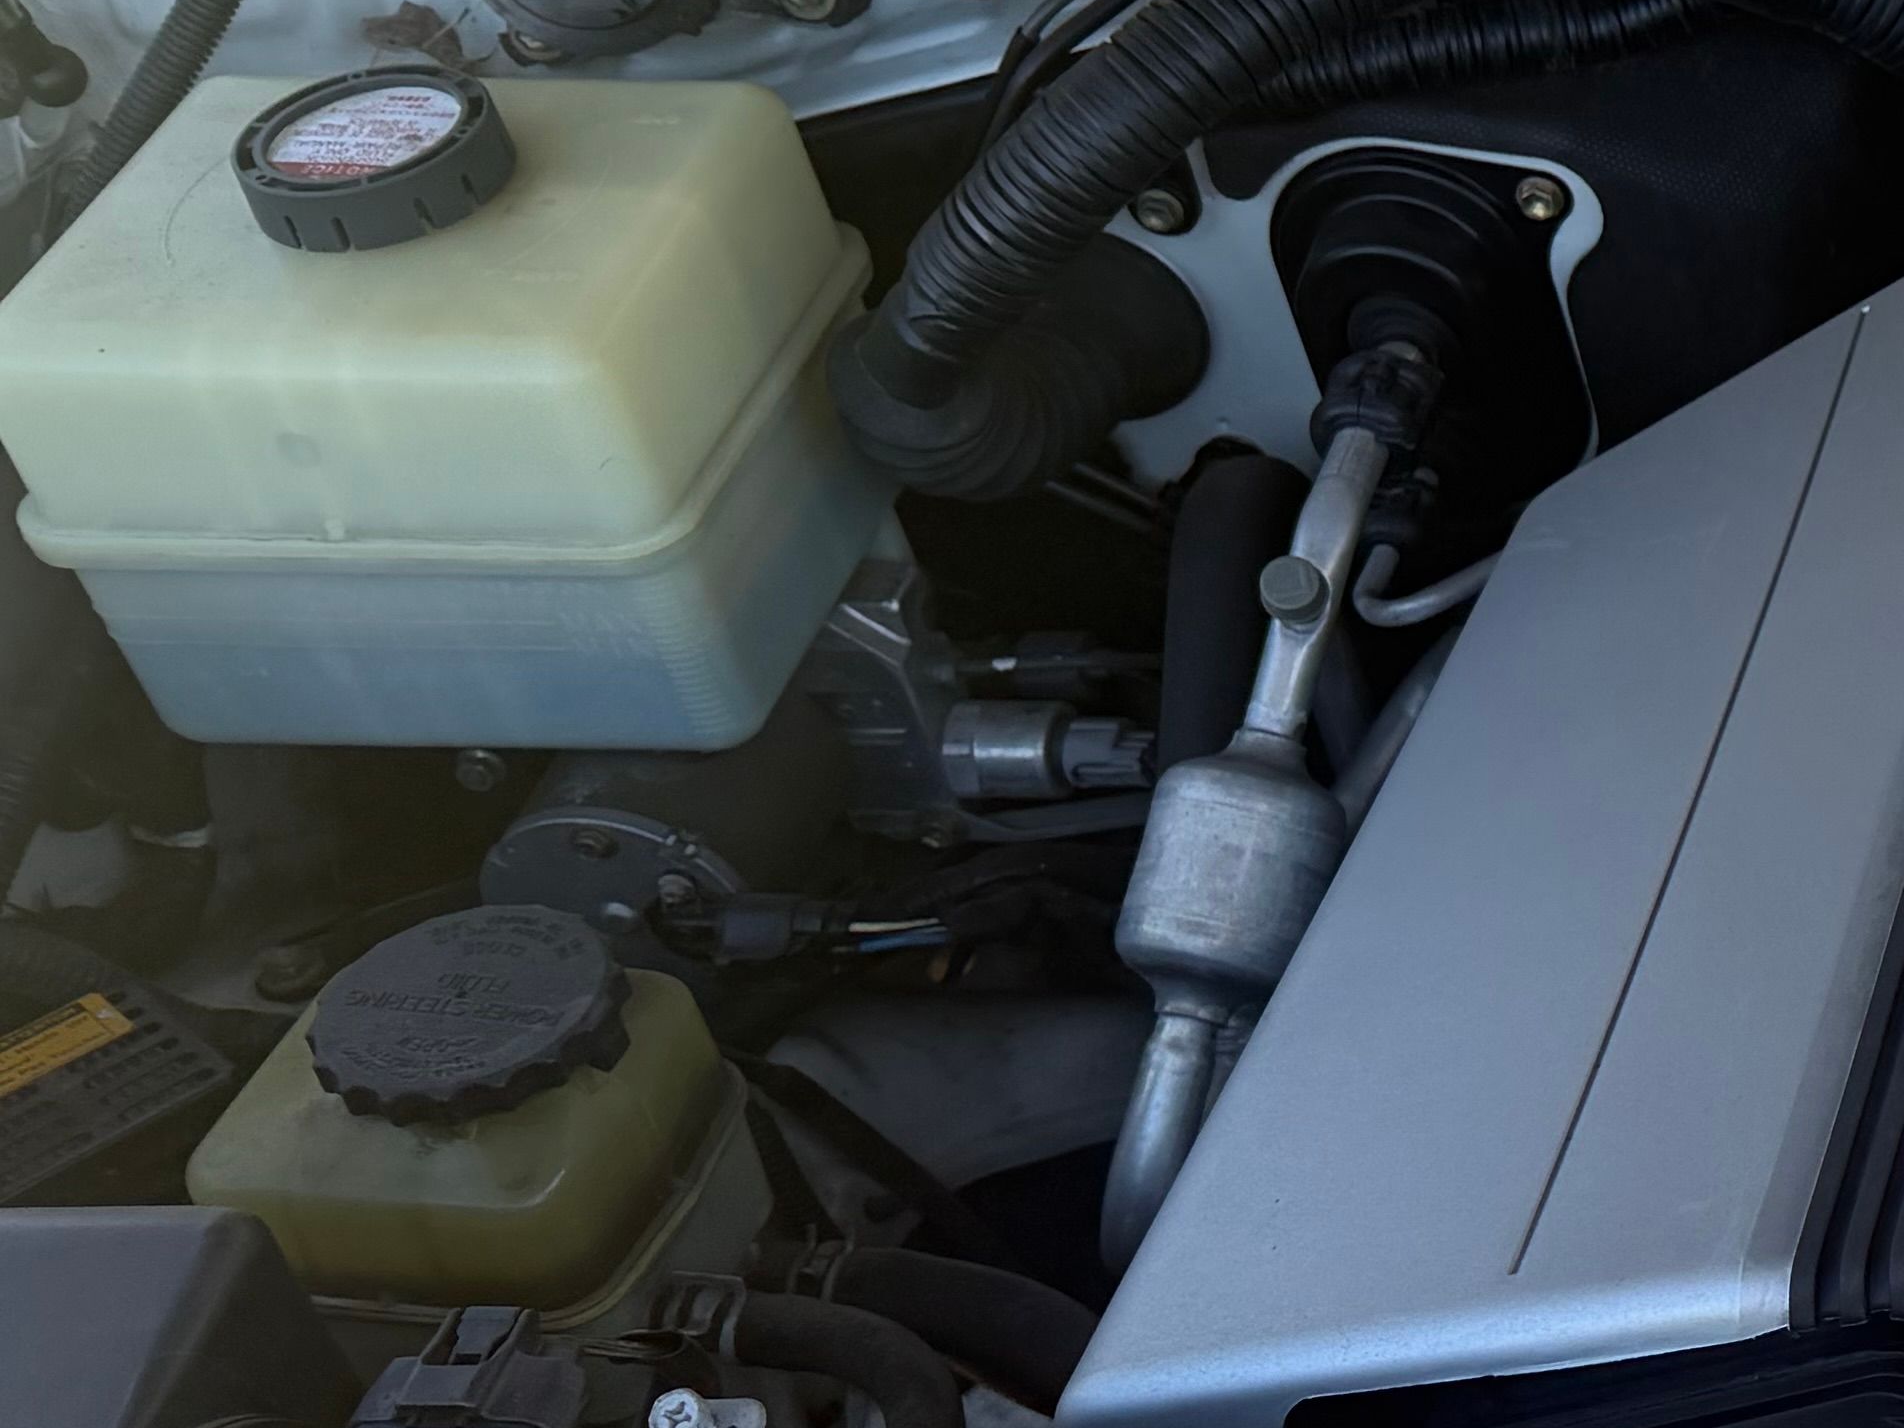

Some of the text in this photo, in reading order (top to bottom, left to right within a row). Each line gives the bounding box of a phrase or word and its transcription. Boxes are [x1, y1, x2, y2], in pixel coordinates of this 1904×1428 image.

[301, 164, 376, 175] NOTICE
[436, 972, 512, 996] FLUID
[343, 988, 564, 1027] POWER STEERING
